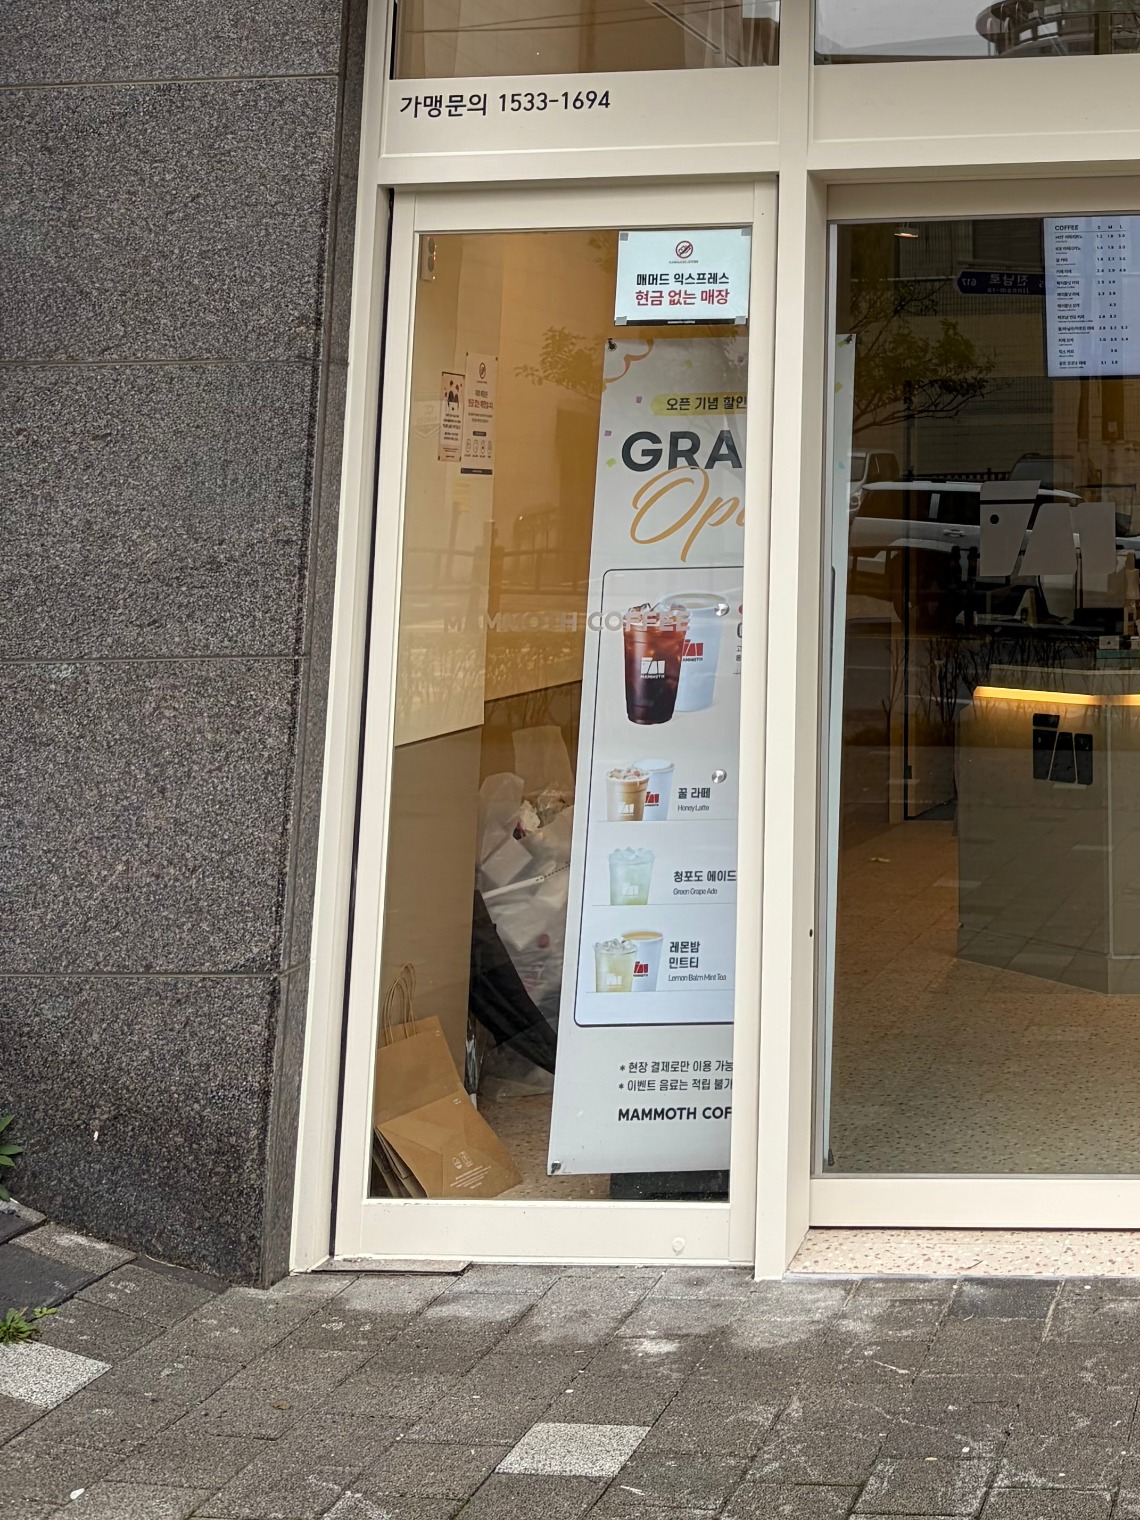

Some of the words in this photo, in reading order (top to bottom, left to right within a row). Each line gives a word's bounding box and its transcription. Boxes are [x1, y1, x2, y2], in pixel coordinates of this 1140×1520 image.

[400, 94, 487, 118] 가맹문의
[499, 90, 610, 111] 1533-1694
[636, 273, 670, 286] 매머드
[674, 272, 730, 286] 익스프레스
[635, 290, 664, 306] 현금
[668, 290, 697, 306] 없는
[700, 288, 730, 305] 매장
[666, 397, 691, 411] 오픈
[694, 396, 719, 410] 기념
[723, 396, 747, 410] 할인
[622, 430, 742, 472] GRA
[587, 611, 691, 632] COFFEE
[678, 788, 688, 799] 꿀
[690, 787, 711, 799] 라떼
[672, 870, 704, 882] 청포도
[706, 870, 737, 882] 에이드
[669, 941, 700, 954] 레몬밤
[668, 956, 700, 970] 민트티
[628, 1062, 648, 1074] 현장
[650, 1061, 690, 1074] 결제로만
[692, 1060, 712, 1072] 이용
[715, 1060, 734, 1072] 가능
[627, 1080, 656, 1092] 이벤트
[659, 1080, 688, 1091] 음료는
[692, 1079, 711, 1090] 적립
[618, 1107, 697, 1122] MAMMOTH
[702, 1106, 732, 1120] COF
